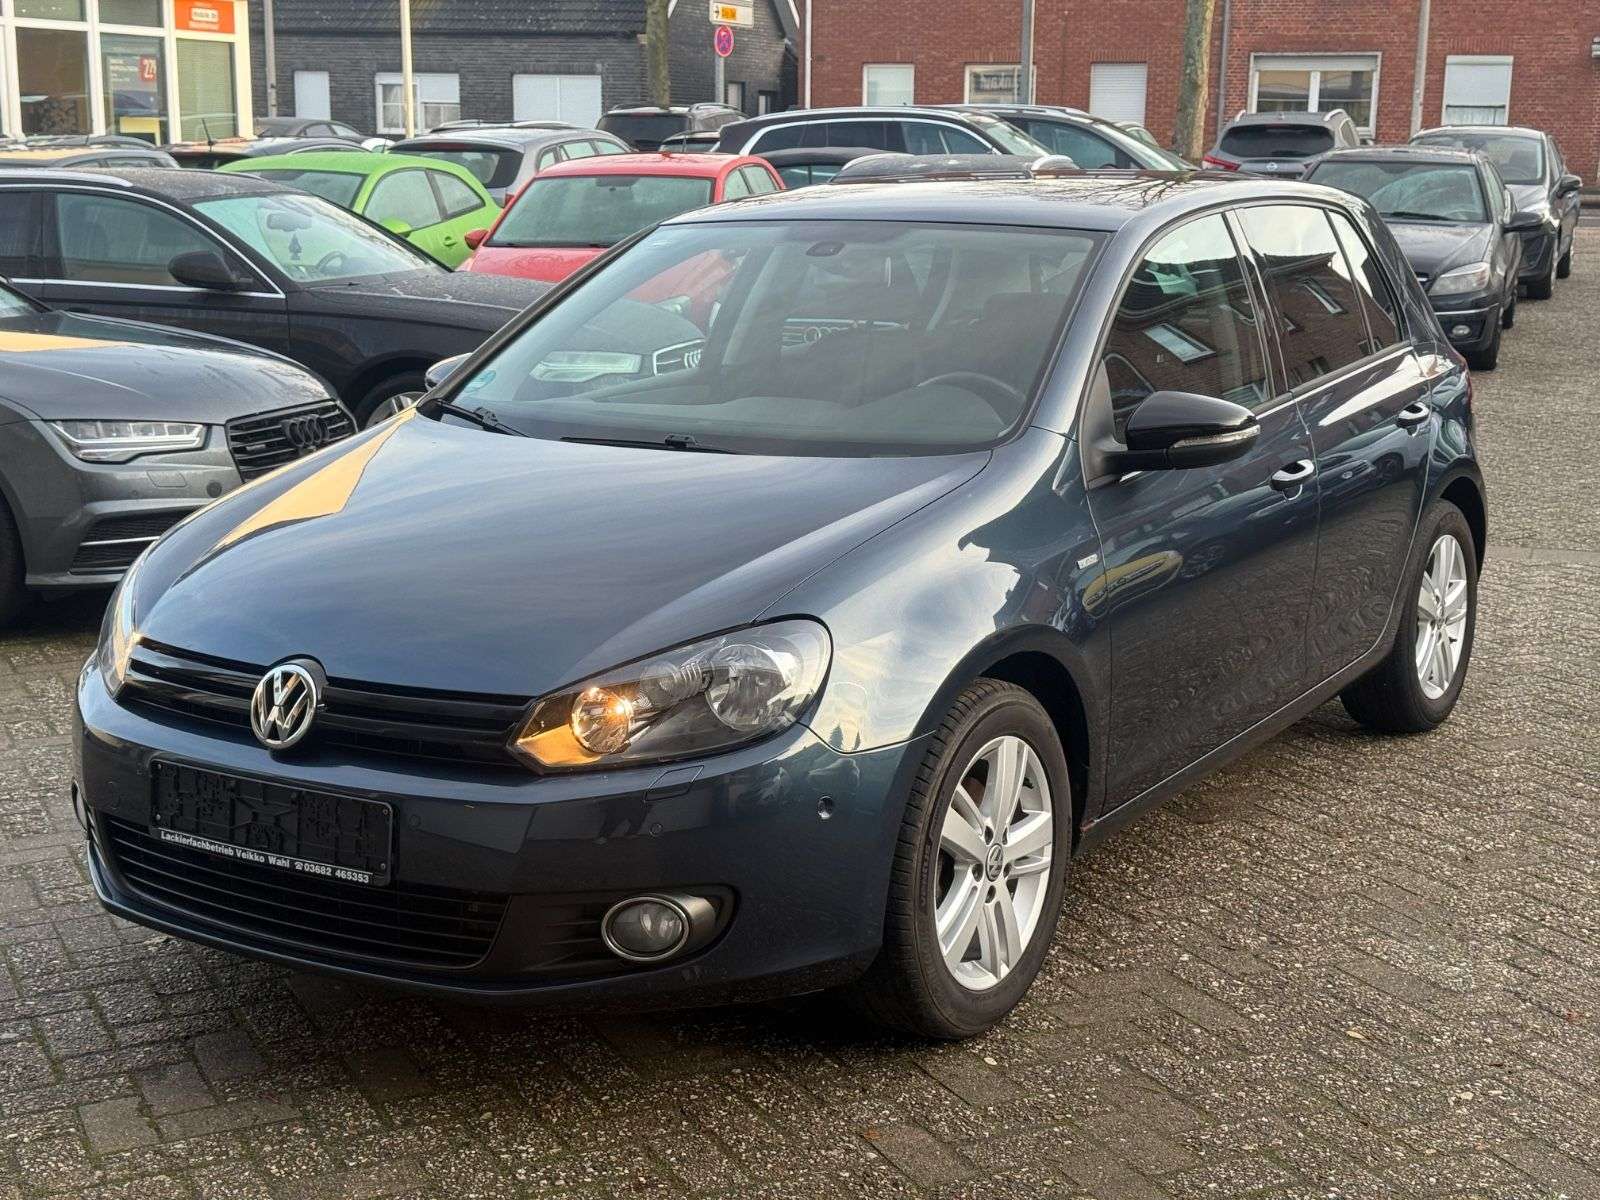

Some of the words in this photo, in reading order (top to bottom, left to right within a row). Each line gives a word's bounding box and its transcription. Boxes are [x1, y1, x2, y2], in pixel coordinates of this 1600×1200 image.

[160, 830, 234, 856] Lackierfachbetrieb
[235, 848, 265, 863] Veikko
[267, 855, 290, 868] Wahl
[335, 869, 370, 884] 465353
